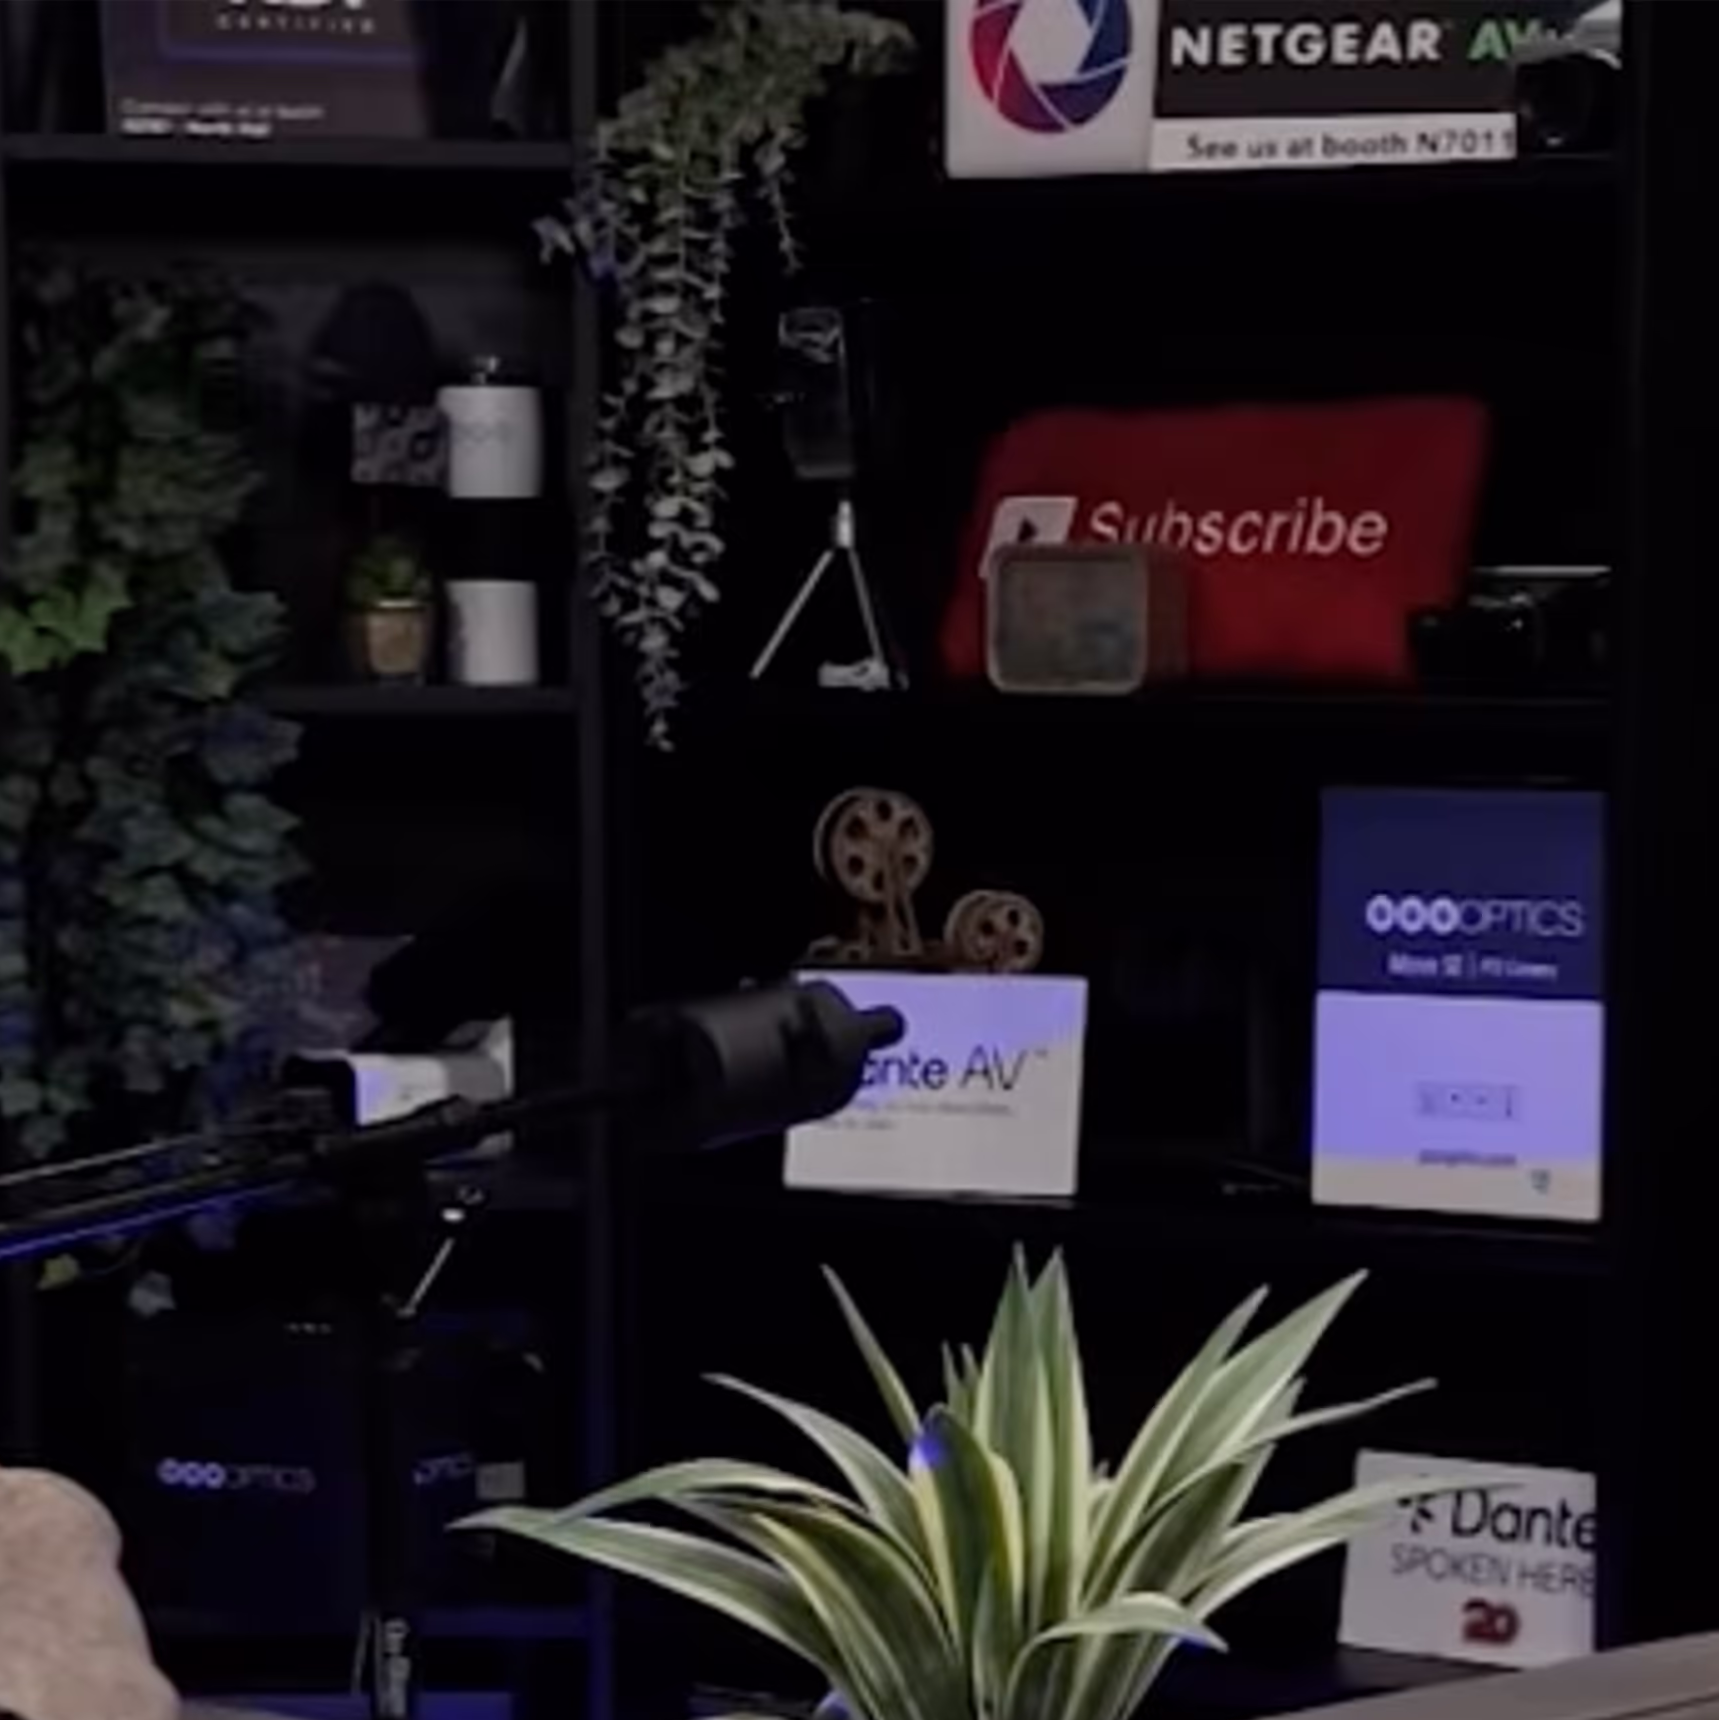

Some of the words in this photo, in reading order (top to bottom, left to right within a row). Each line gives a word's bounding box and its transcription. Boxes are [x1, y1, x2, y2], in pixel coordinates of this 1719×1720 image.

[1170, 20, 1442, 66] NETGEAR
[1187, 133, 1238, 159] See
[1247, 139, 1278, 159] us
[1286, 136, 1314, 159] at
[1321, 132, 1408, 157] booth
[1090, 497, 1387, 554] Subscribe
[863, 1049, 949, 1091] ante
[958, 1044, 1028, 1091] AV
[1450, 1487, 1596, 1553] Dante
[1390, 1543, 1511, 1586] SPOKEN
